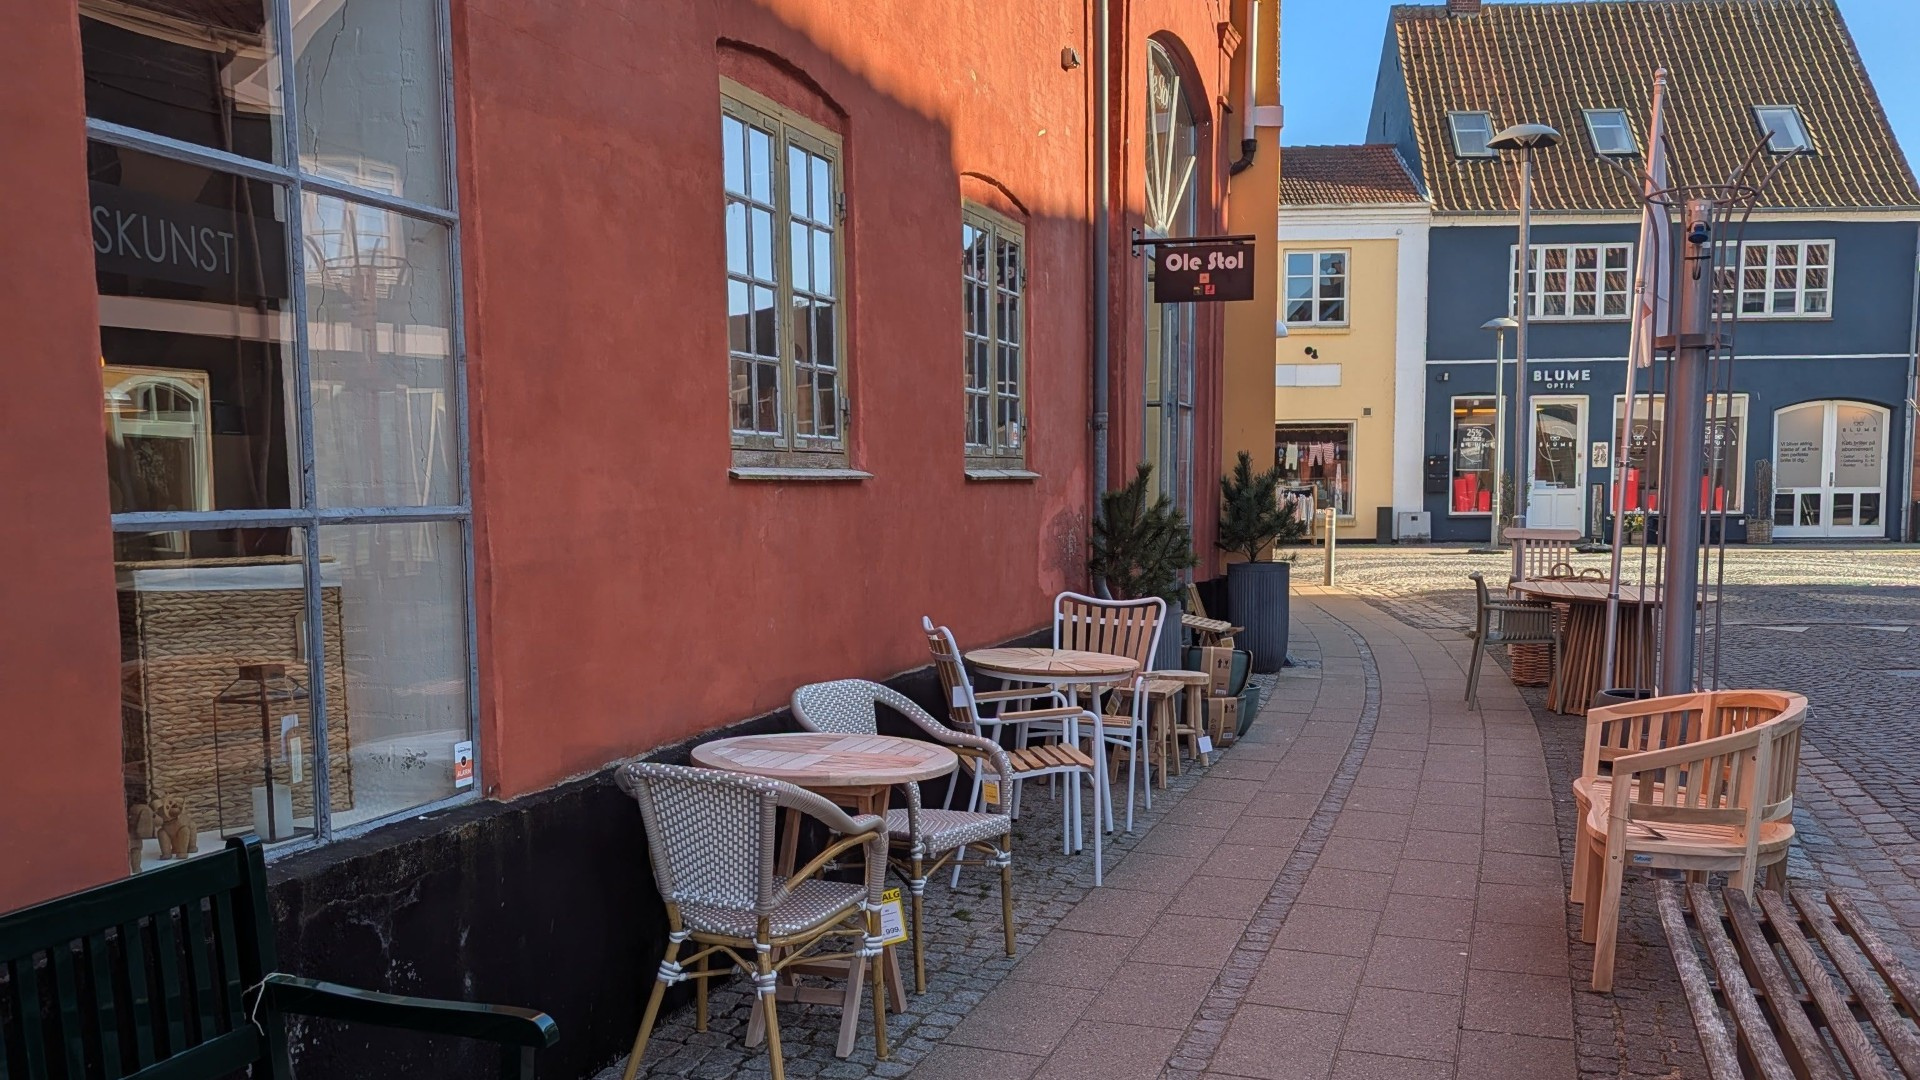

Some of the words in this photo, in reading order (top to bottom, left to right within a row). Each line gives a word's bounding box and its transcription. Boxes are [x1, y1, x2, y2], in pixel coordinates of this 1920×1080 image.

[1165, 253, 1202, 272] Ole
[1207, 251, 1244, 271] Stol
[1533, 369, 1591, 382] BLUME
[882, 891, 900, 901] ALG
